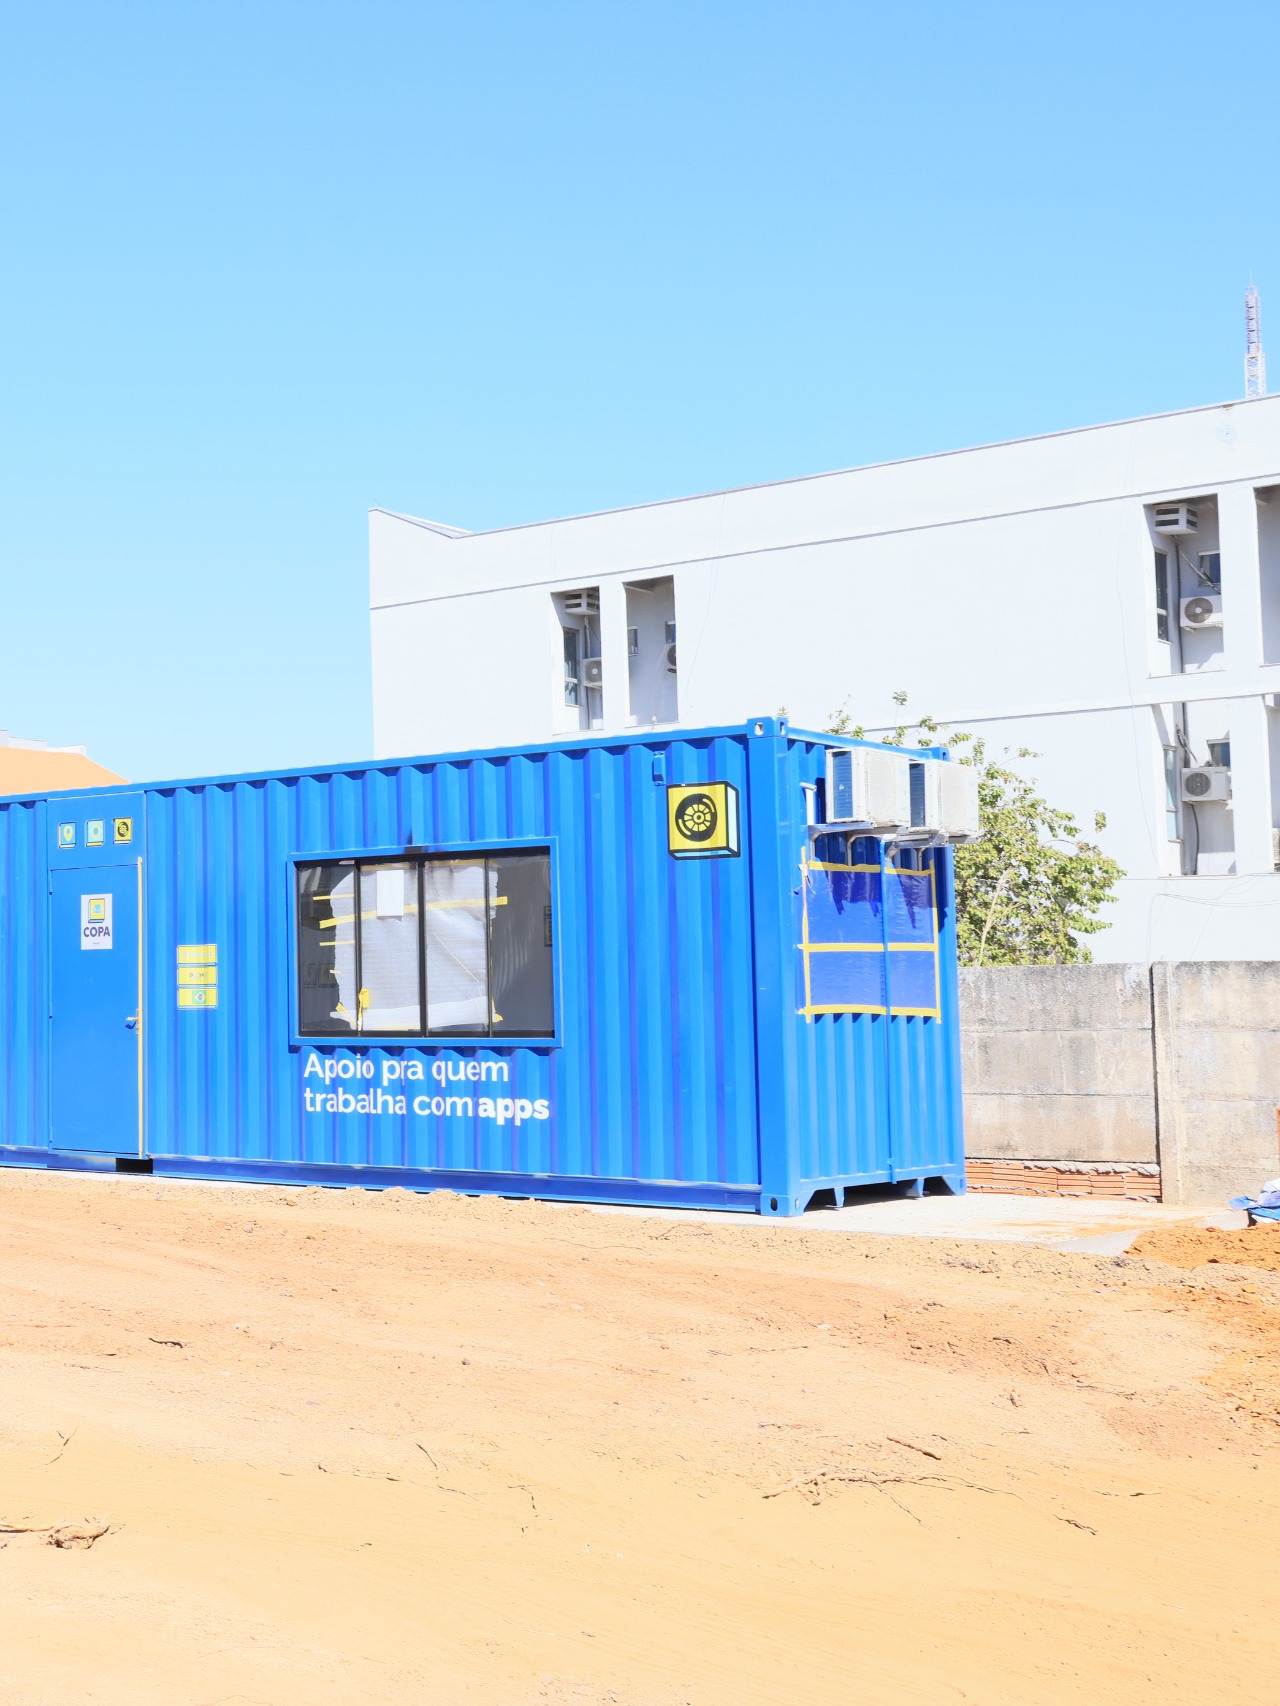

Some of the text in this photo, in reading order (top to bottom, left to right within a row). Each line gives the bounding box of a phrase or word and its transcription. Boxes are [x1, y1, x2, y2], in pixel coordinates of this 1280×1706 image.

[83, 926, 111, 938] COPA
[303, 1053, 509, 1087] Apoio pra quem
[304, 1087, 549, 1127] trabalha com apps
